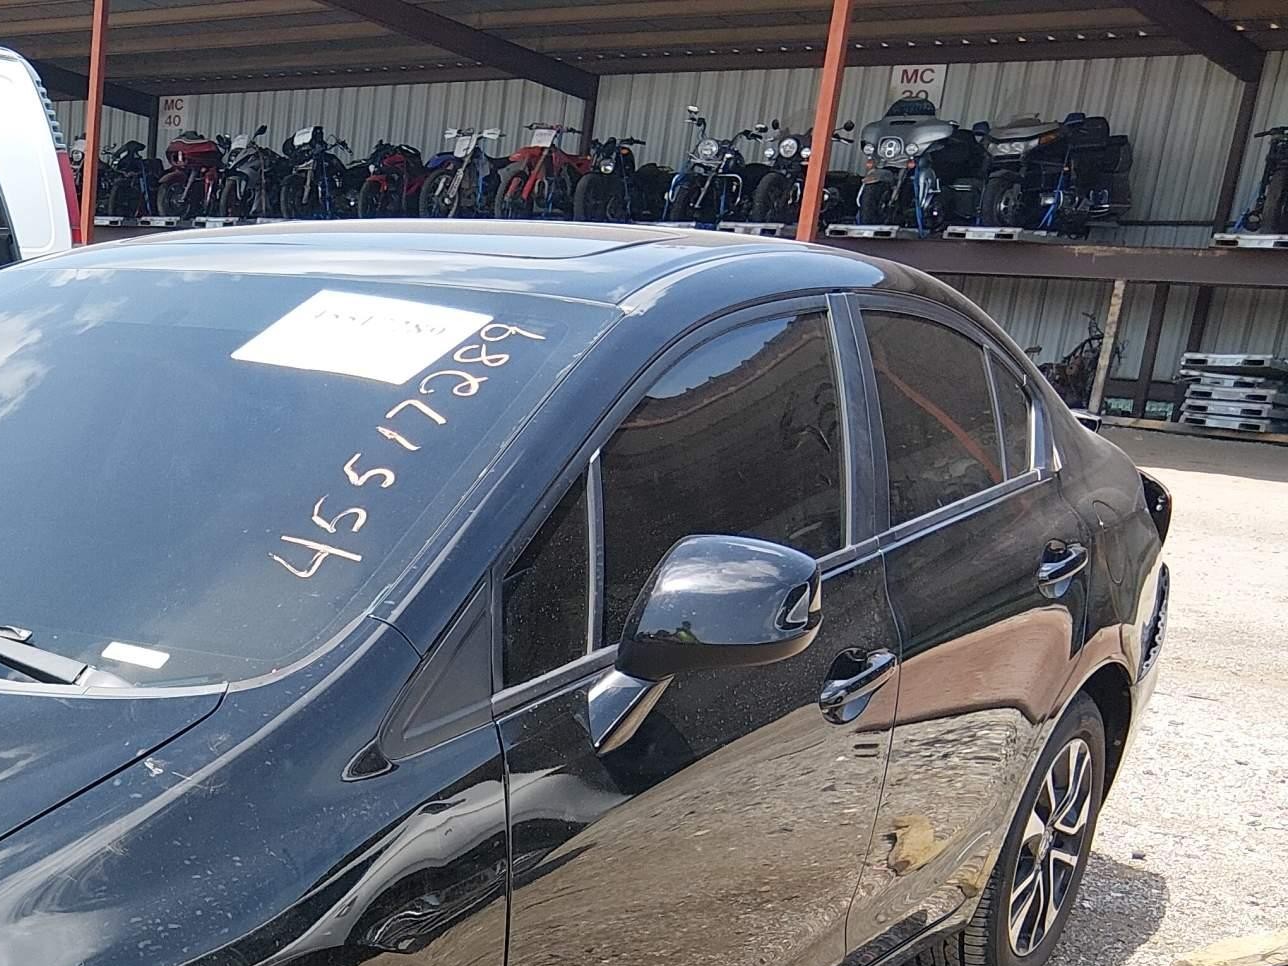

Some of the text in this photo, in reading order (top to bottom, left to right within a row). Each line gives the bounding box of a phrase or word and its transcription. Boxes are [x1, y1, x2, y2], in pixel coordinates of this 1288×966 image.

[900, 68, 935, 84] MC
[164, 98, 184, 111] MC
[164, 114, 182, 127] 40
[267, 322, 546, 578] 45517289
